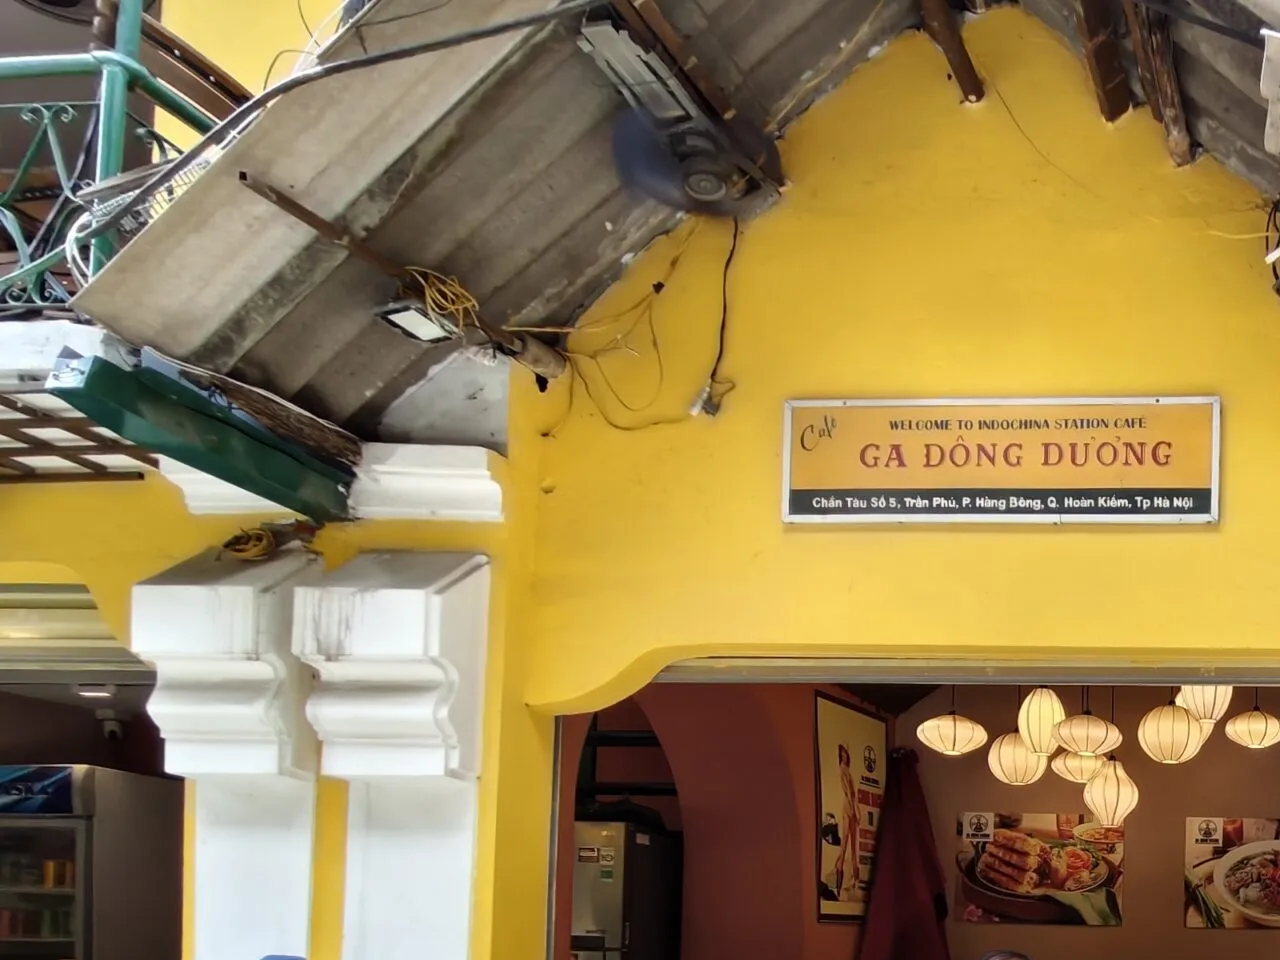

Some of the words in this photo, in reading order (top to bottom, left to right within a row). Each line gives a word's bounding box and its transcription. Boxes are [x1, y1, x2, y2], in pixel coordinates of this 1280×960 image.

[889, 419, 952, 431] WELCOME
[957, 419, 973, 431] TO
[978, 418, 1050, 431] INDOCHINA
[1054, 418, 1109, 430] STATION
[859, 443, 907, 468] GA
[888, 496, 901, 511] 5,
[962, 497, 973, 509] P.
[1047, 496, 1060, 509] Q.
[1064, 496, 1094, 509] Hoàn
[1135, 497, 1151, 512] Tp
[1154, 496, 1170, 509] Hà
